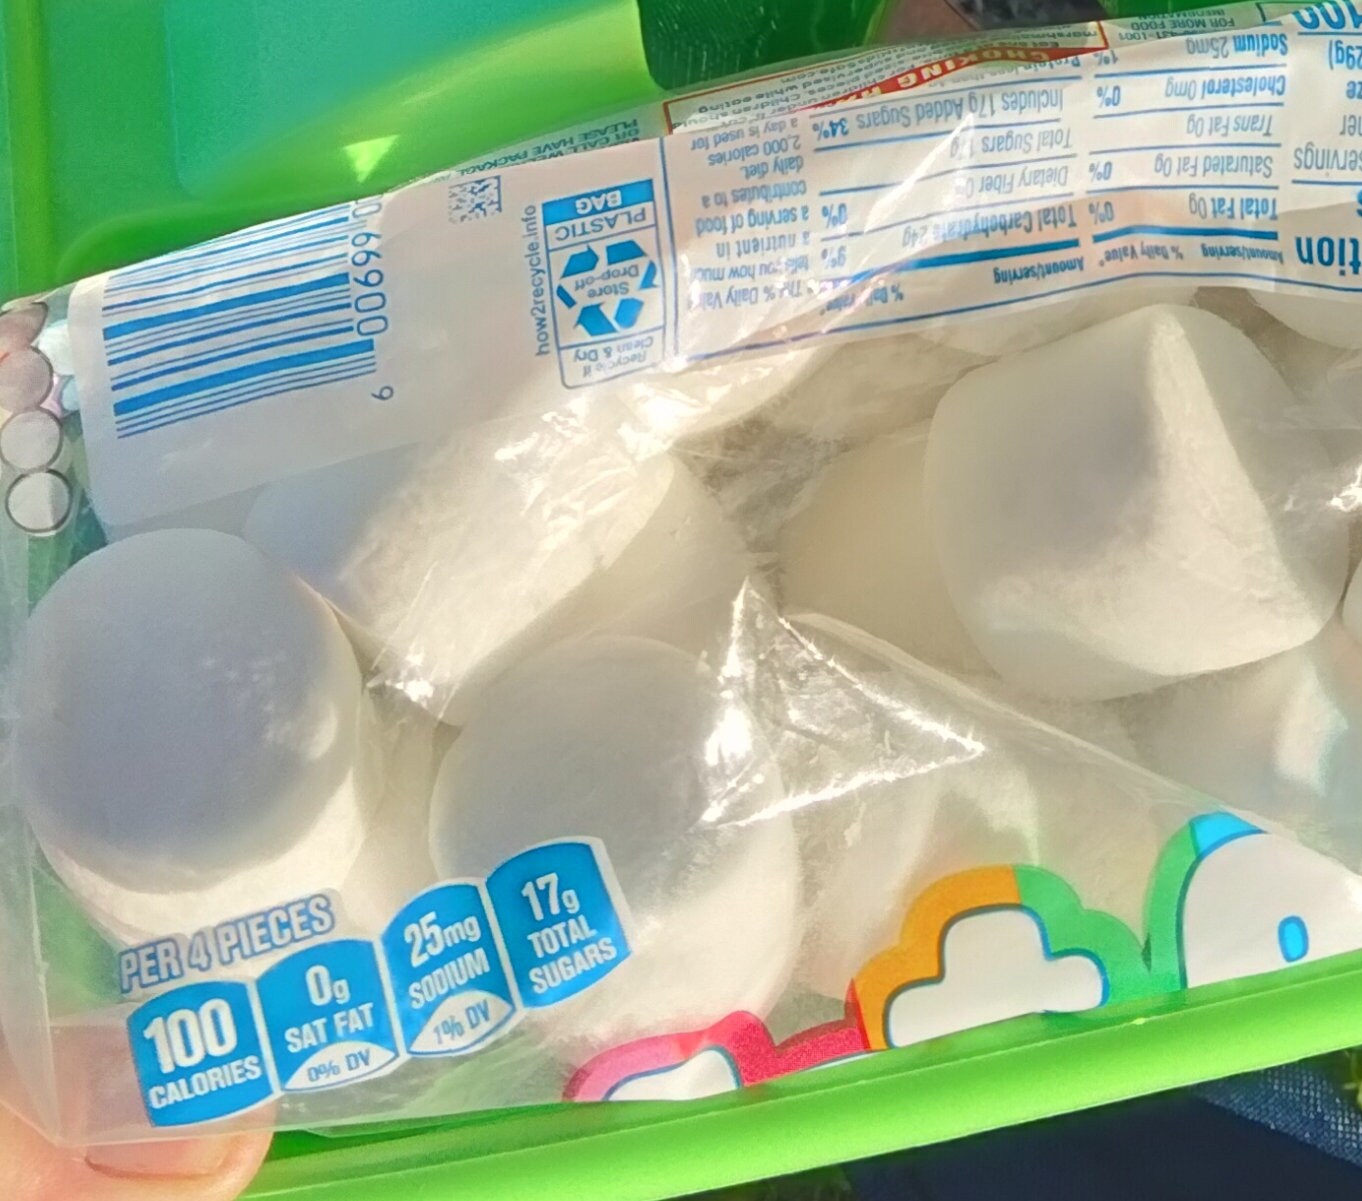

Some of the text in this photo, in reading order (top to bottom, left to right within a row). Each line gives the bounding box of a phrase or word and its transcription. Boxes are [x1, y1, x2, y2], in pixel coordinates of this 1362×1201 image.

[1130, 17, 1235, 31] FOR MORE FOOD
[1093, 49, 1119, 66] 1%
[1185, 35, 1230, 59] 25mg
[1232, 33, 1288, 57] Sodium
[897, 49, 1050, 88] CHOKING
[1096, 75, 1286, 107] Cholesterol 0mg 0%
[812, 88, 1063, 141] Includes 17g Added Sugars 34%
[1186, 114, 1272, 138] Trans Fat 0g
[532, 135, 574, 155] HAVE
[577, 119, 639, 143] PLEASE
[690, 117, 798, 152] a day is used for
[950, 127, 1071, 159] Total Sugars 1g
[707, 134, 800, 168] 2,000 calories
[739, 155, 804, 180] daily diet.
[1017, 164, 1068, 191] Dietary
[1089, 153, 1273, 181] Saturated Fat 0g 0%
[701, 180, 807, 209] contributes to a
[979, 172, 1014, 196] Fiber
[575, 189, 622, 215] BAG
[821, 202, 848, 228] 0%
[1088, 192, 1279, 227] Total Fat 0g 0%
[554, 207, 646, 241] PLASTIC
[694, 205, 809, 237] a serving of food
[1037, 203, 1077, 232] Total
[715, 241, 730, 261] in
[736, 232, 797, 258] nutrient
[1140, 242, 1169, 259] Daily
[1201, 243, 1284, 264] Amount/serving
[520, 204, 551, 357] how2recycle.info
[573, 264, 639, 291] Drop-off
[727, 263, 756, 280] how
[993, 256, 1084, 285] Amount/serving
[587, 281, 629, 300] Store
[726, 285, 759, 308] Daily
[573, 348, 598, 363] Dry
[520, 871, 580, 922] 17g
[119, 893, 336, 996] PER 4 PIECES
[403, 910, 483, 970] 25mg
[527, 916, 598, 959] TOTAL
[408, 947, 491, 1010] SODIUM
[528, 936, 619, 996] SUGARS
[305, 963, 350, 1008] 0g
[142, 996, 240, 1075] 100
[284, 1002, 376, 1054] SAT FAT
[431, 998, 492, 1046] 1% DV
[306, 1046, 372, 1084] 0% DV
[147, 1053, 263, 1111] CALORIES
